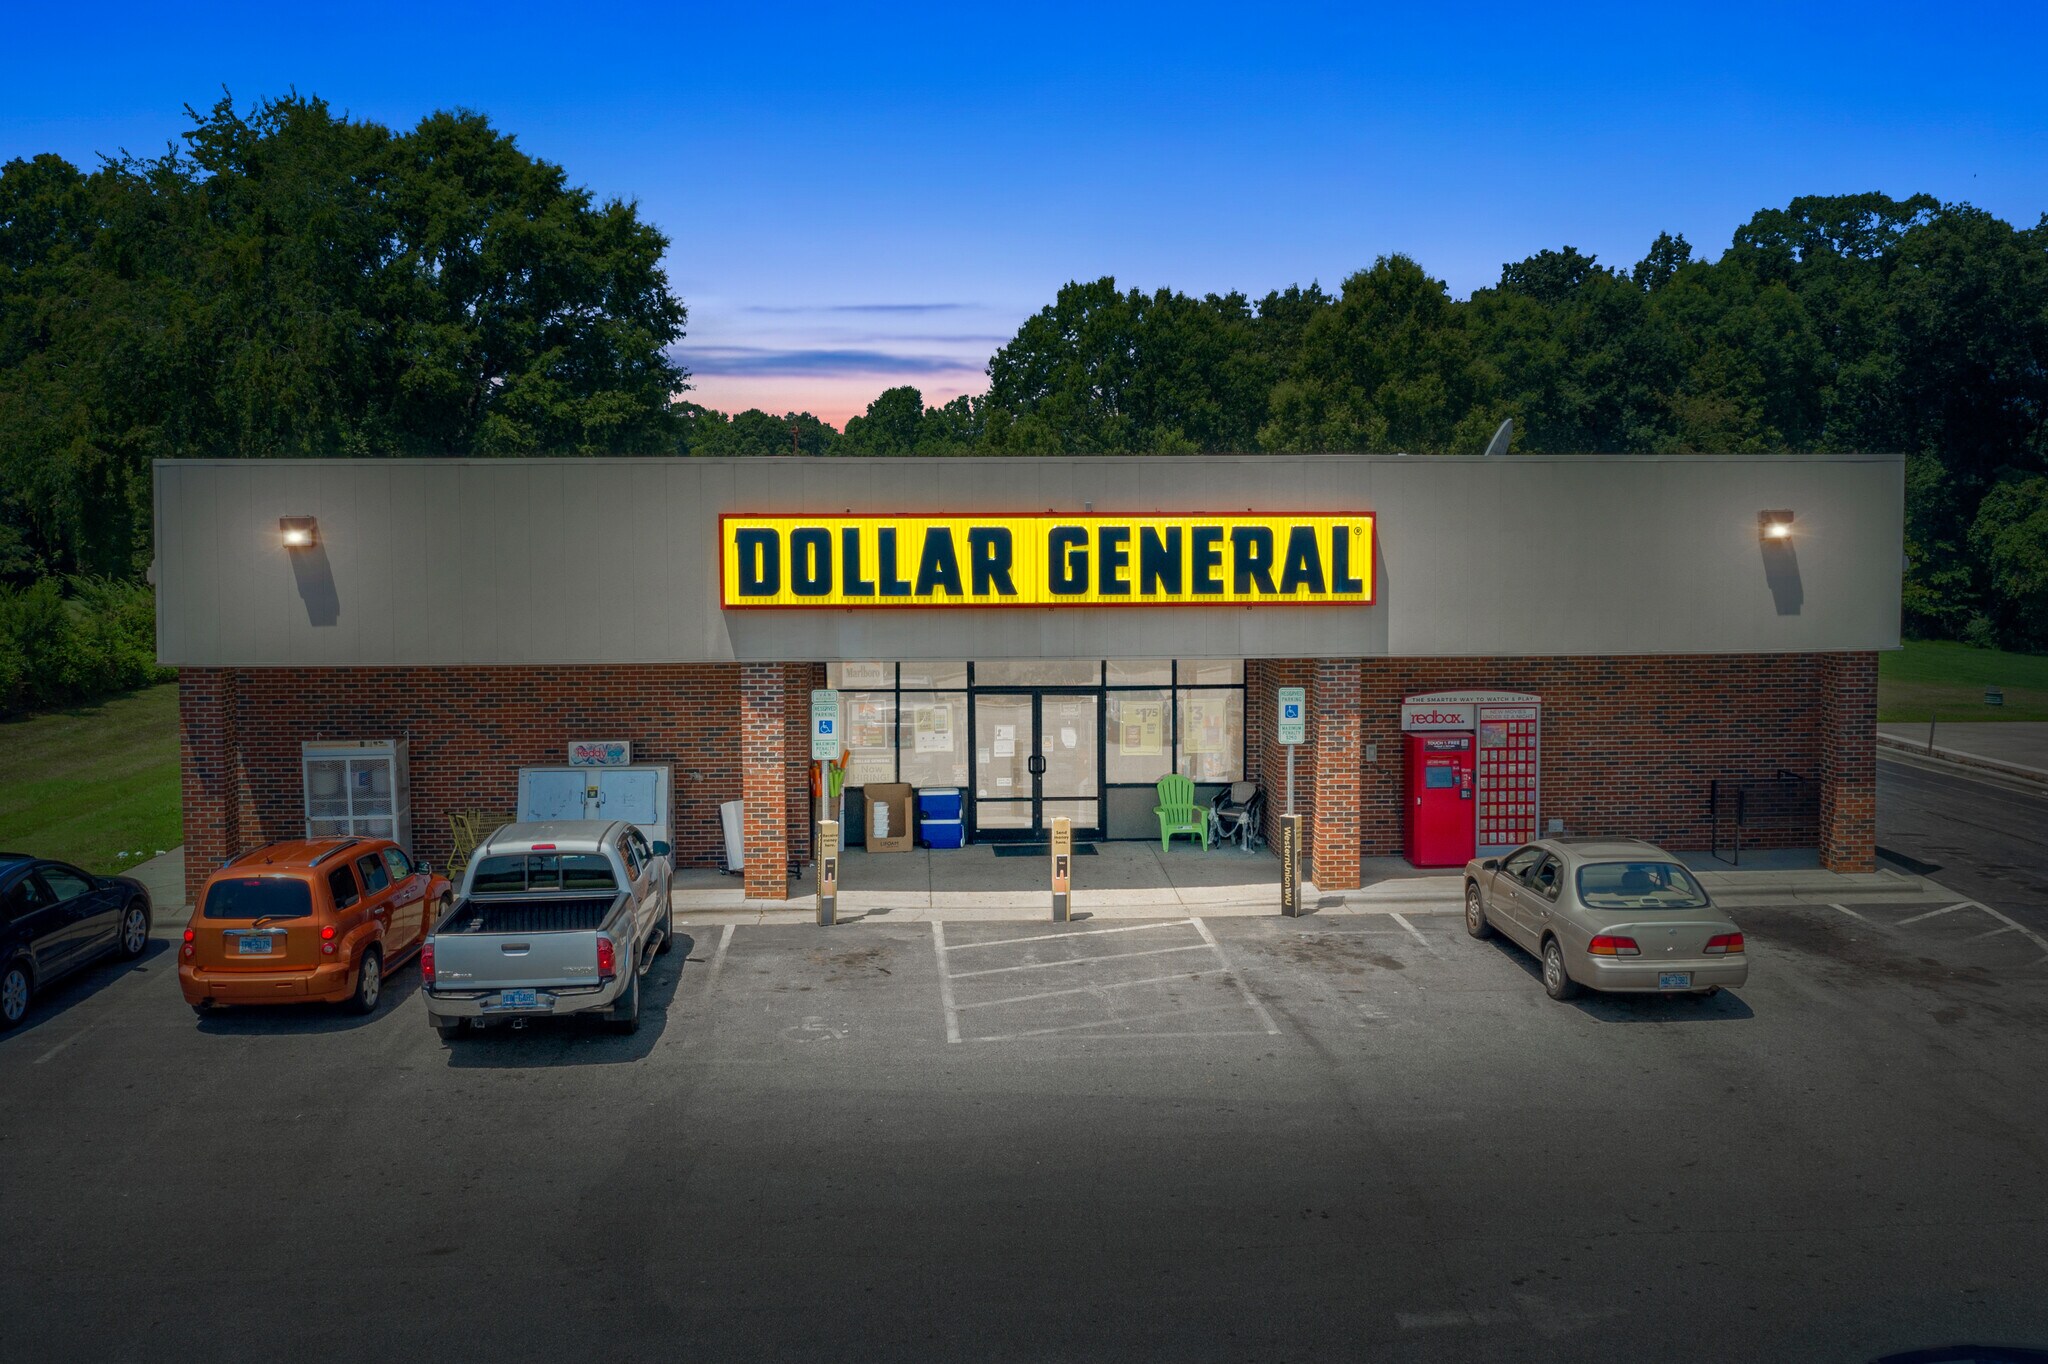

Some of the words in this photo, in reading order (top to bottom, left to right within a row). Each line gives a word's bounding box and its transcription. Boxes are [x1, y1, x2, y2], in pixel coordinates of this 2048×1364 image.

[734, 526, 1017, 597] DOLLAR
[1048, 525, 1363, 595] GENERAL
[846, 665, 880, 678] Marlboro
[575, 747, 606, 760] Reddy
[852, 773, 891, 781] HIRING!
